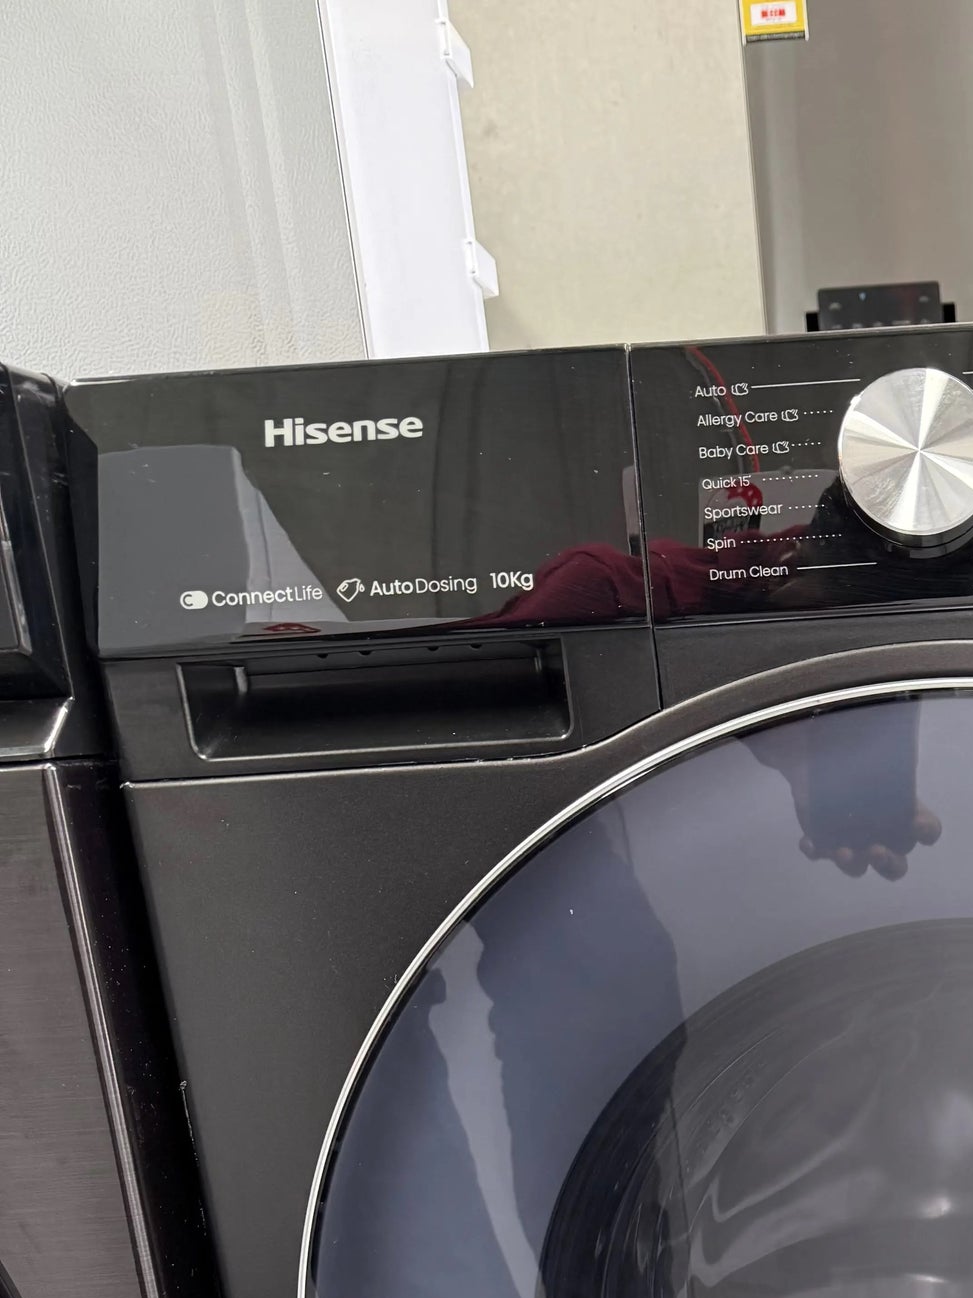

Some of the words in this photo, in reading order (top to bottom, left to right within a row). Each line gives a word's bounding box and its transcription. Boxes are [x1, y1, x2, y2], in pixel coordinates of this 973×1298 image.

[695, 386, 726, 397] Auto
[698, 414, 742, 427] Allergy
[745, 411, 778, 423] Care
[265, 417, 423, 447] Hisense
[700, 446, 733, 459] Baby
[736, 444, 768, 456] Care
[702, 477, 736, 489] Quick
[704, 504, 783, 521] Sportswear
[707, 537, 736, 552] Spin
[709, 569, 746, 581] Drum
[750, 565, 788, 577] Clean
[212, 586, 322, 606] ConnectLife
[490, 571, 534, 590] 10Kg
